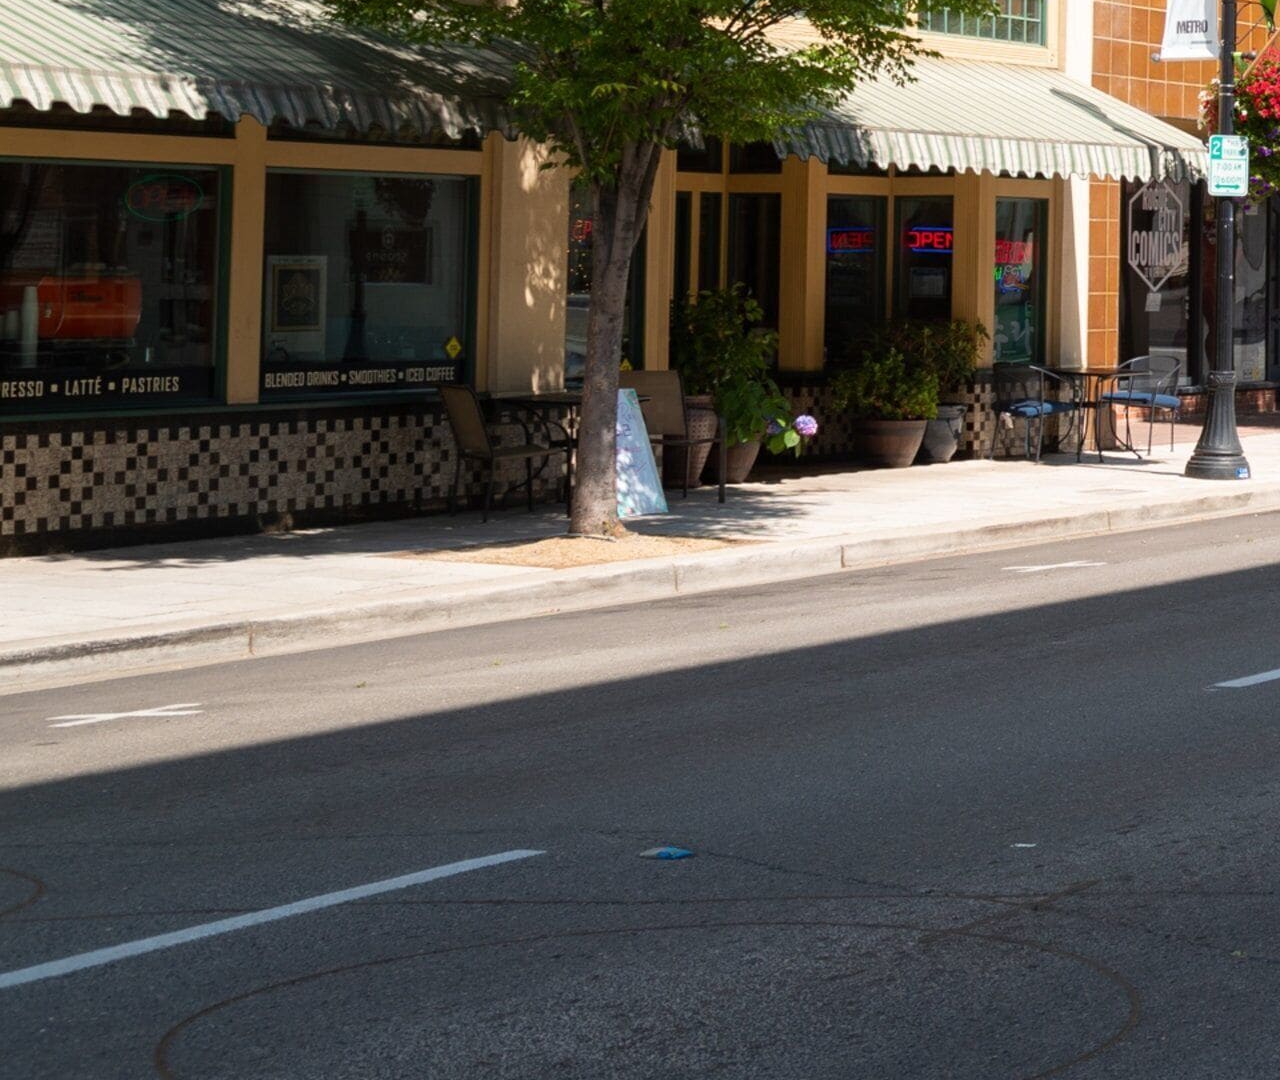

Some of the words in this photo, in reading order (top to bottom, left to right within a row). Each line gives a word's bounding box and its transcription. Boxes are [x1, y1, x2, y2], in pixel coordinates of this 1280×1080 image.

[1176, 20, 1208, 34] METRO
[1212, 141, 1221, 155] 2
[1131, 230, 1180, 267] COMICS
[0, 381, 44, 398] RESSO
[64, 376, 102, 396] LATTÉ
[122, 376, 180, 394] PASTRIES
[265, 372, 304, 388] BLENDED
[307, 371, 339, 386] DRINKS
[348, 369, 396, 385] SMOOTHIES
[405, 367, 425, 383] ICED
[426, 366, 455, 381] COFFEE
